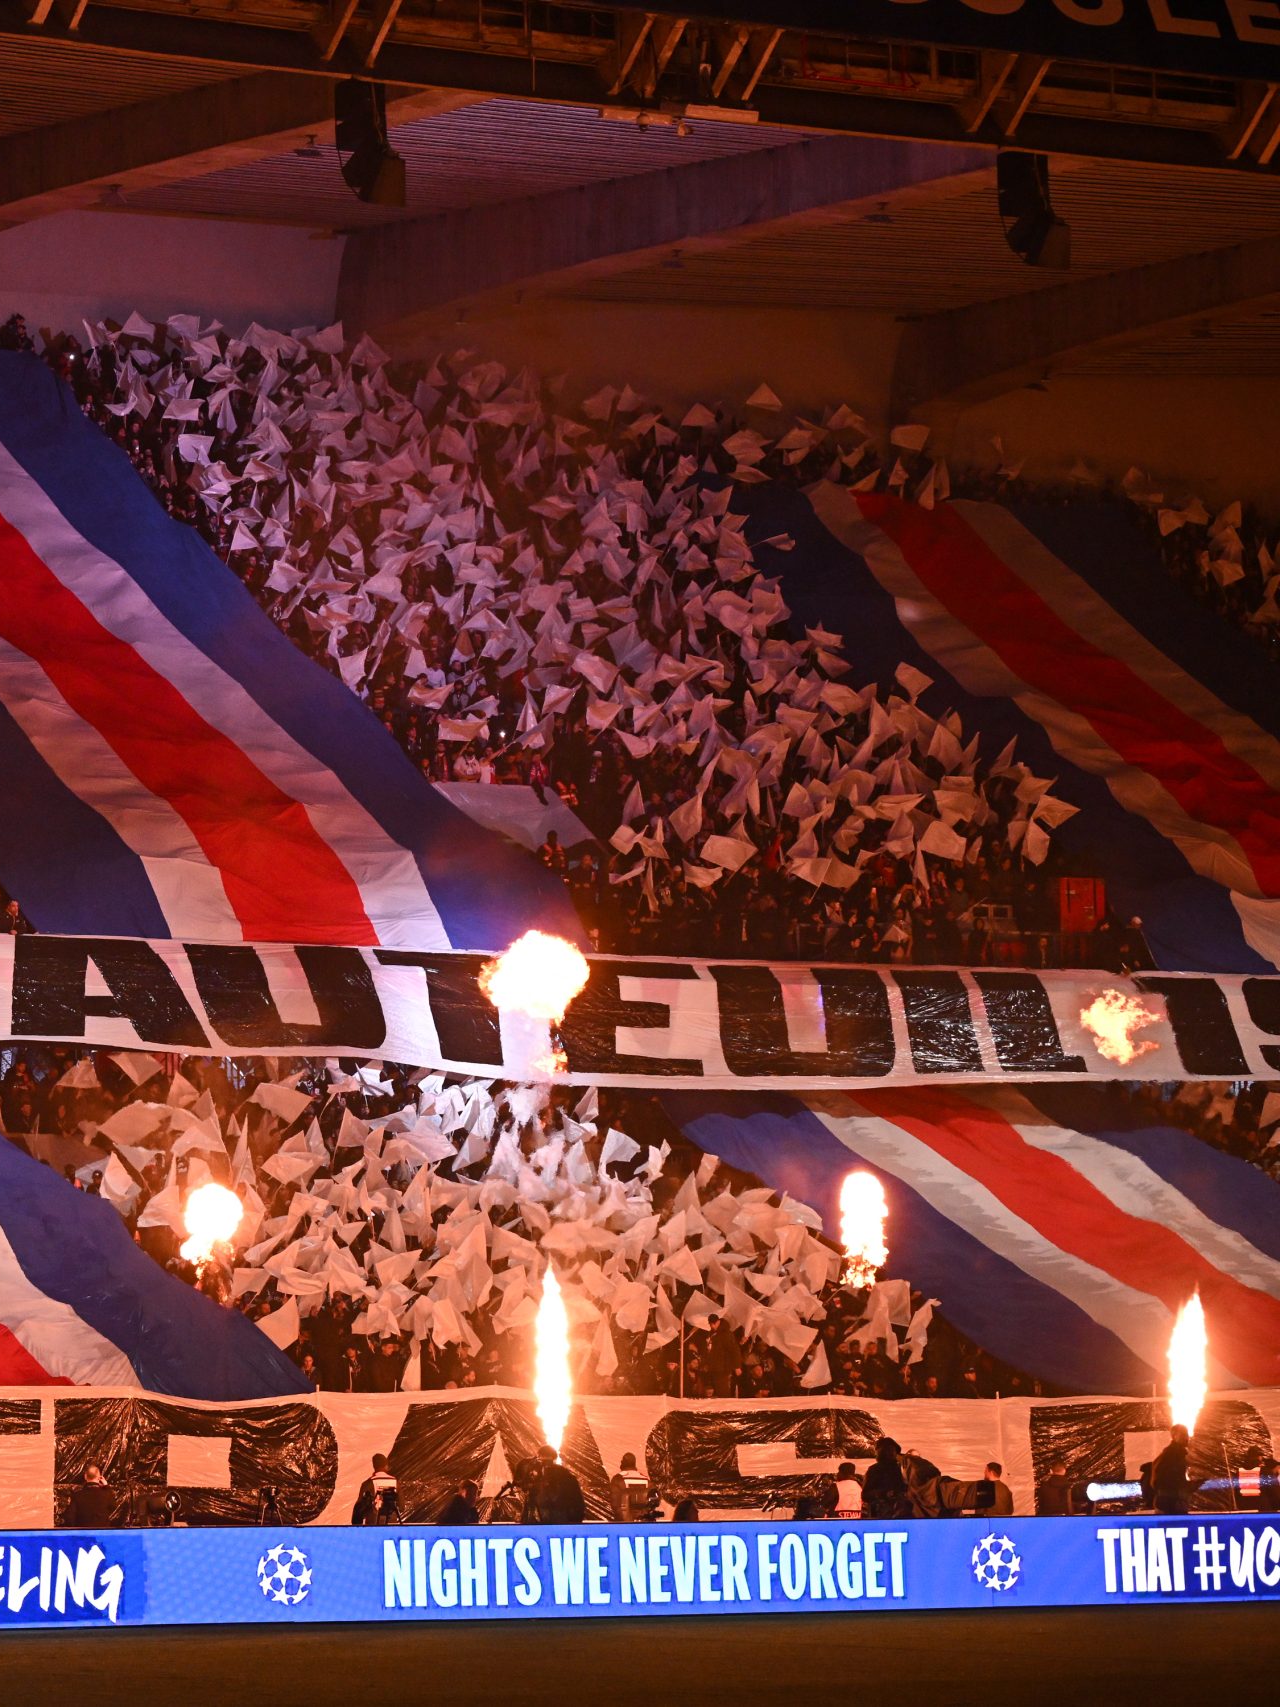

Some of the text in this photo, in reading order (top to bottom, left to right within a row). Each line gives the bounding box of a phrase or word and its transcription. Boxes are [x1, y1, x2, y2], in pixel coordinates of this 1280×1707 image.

[10, 933, 1089, 1077] AUTEUIL
[383, 1532, 908, 1608] NIGHTS WE NEVER FORGET
[1096, 1527, 1189, 1593] THAT
